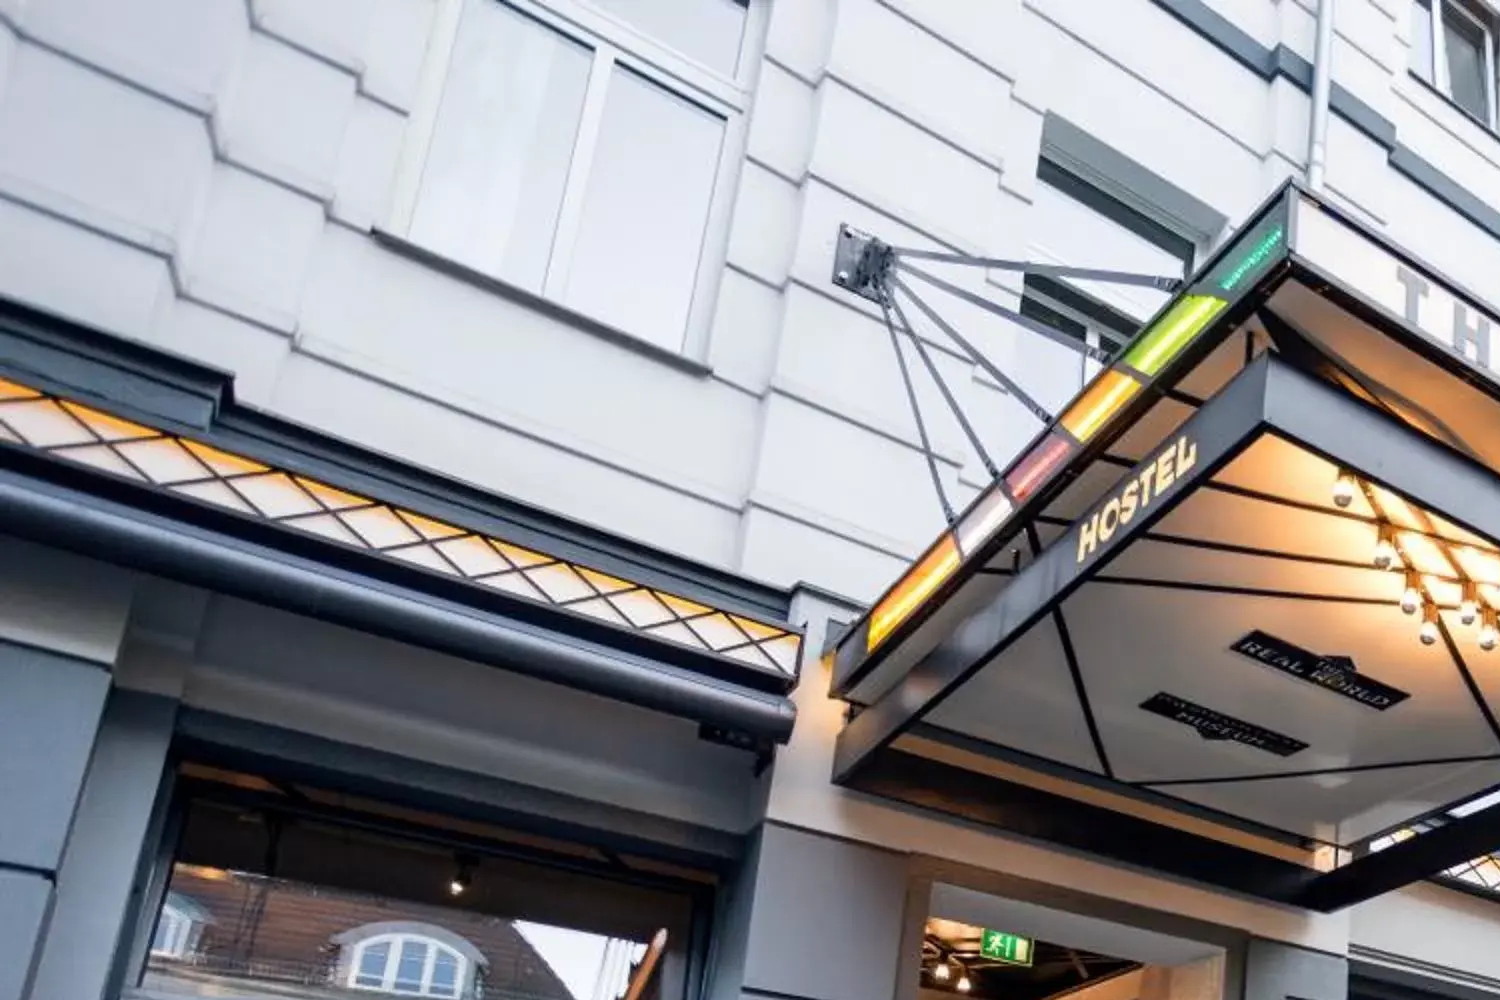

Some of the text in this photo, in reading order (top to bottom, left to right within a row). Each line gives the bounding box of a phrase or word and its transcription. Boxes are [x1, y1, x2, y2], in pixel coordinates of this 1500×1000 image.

[1076, 434, 1198, 563] HOSTEL
[1240, 640, 1391, 706] REAL WORLD
